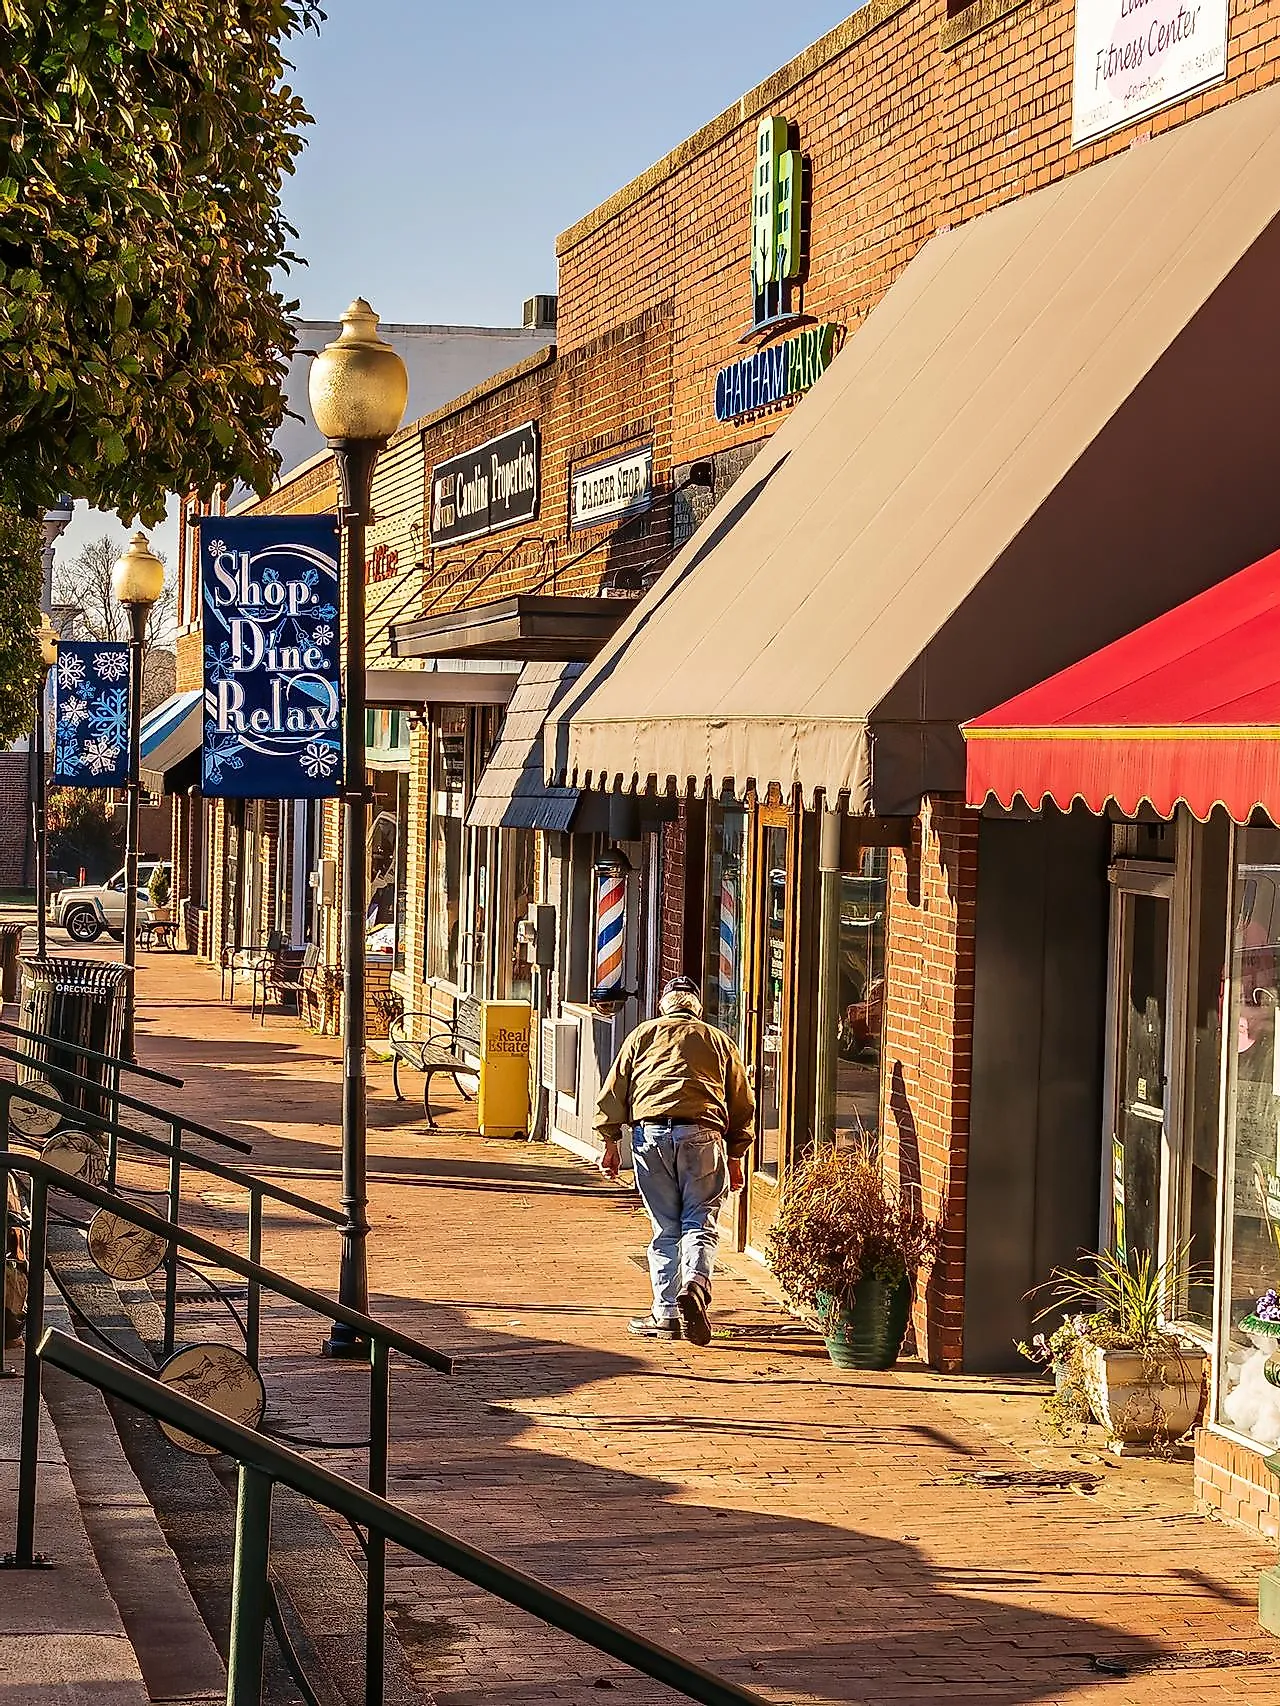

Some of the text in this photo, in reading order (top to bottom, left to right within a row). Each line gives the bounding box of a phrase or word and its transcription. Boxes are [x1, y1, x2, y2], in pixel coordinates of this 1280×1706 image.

[1094, 5, 1201, 90] Fitness Center
[715, 323, 828, 423] CHATHAM PARK
[491, 440, 534, 509] Properties
[581, 466, 640, 511] BARBER SHOP
[213, 550, 319, 616] Shop.
[227, 617, 331, 673] Dine.
[214, 678, 339, 734] Relax.
[488, 1040, 529, 1053] Estate
[498, 1028, 527, 1042] Real
